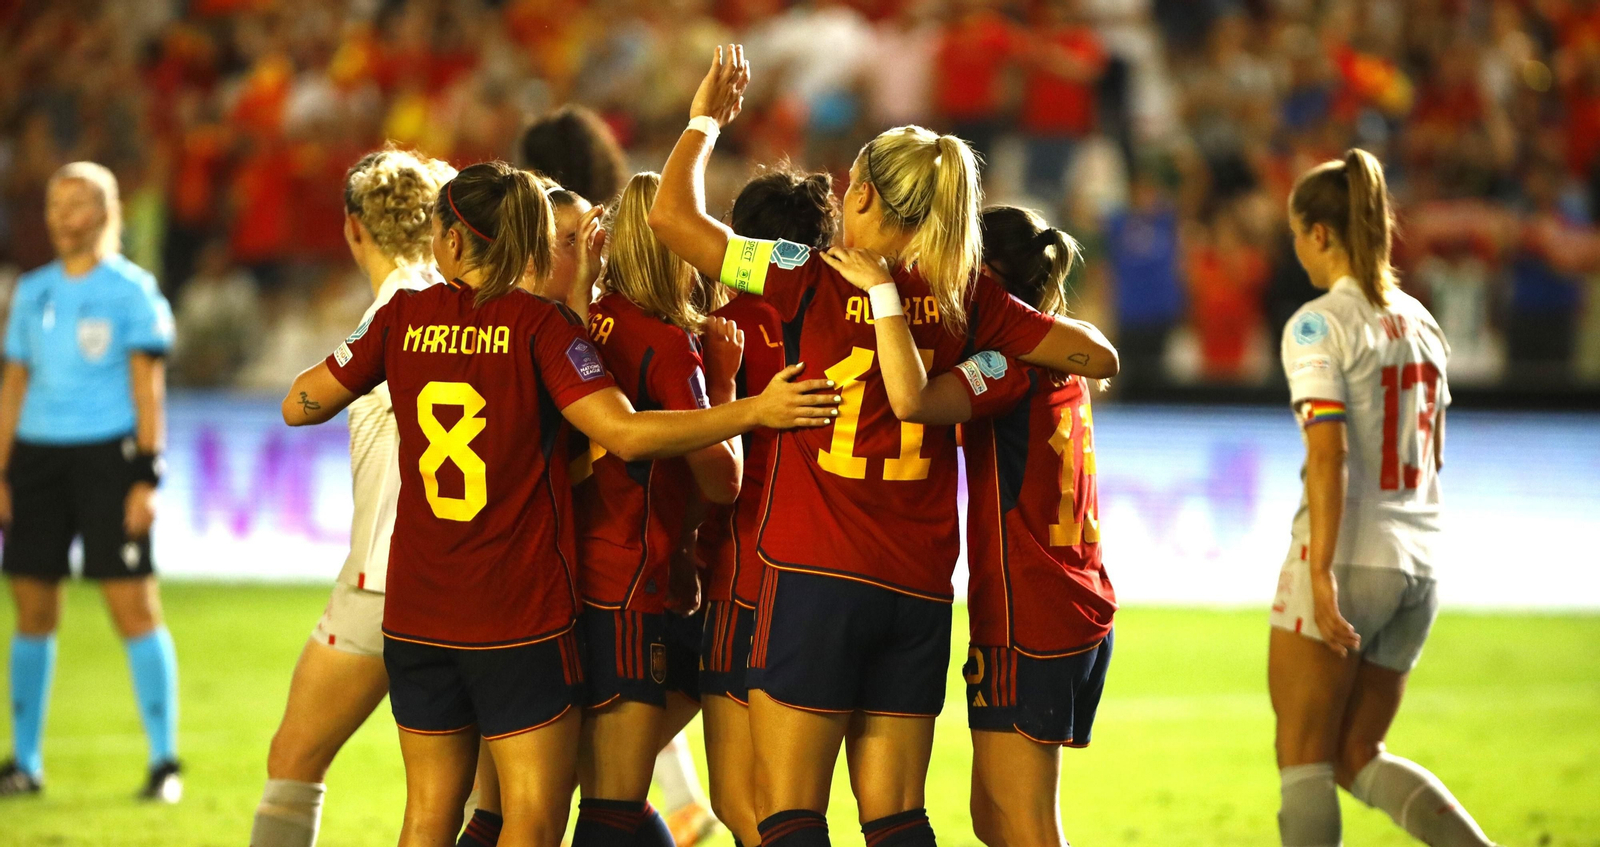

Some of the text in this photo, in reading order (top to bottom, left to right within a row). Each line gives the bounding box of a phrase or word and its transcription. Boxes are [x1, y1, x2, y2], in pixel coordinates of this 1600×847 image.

[403, 323, 510, 355] MARIONA
[759, 324, 783, 347] L.
[845, 296, 940, 325] ALXIA
[417, 381, 487, 521] 8
[817, 346, 935, 480] 11
[1380, 362, 1438, 490] 13
